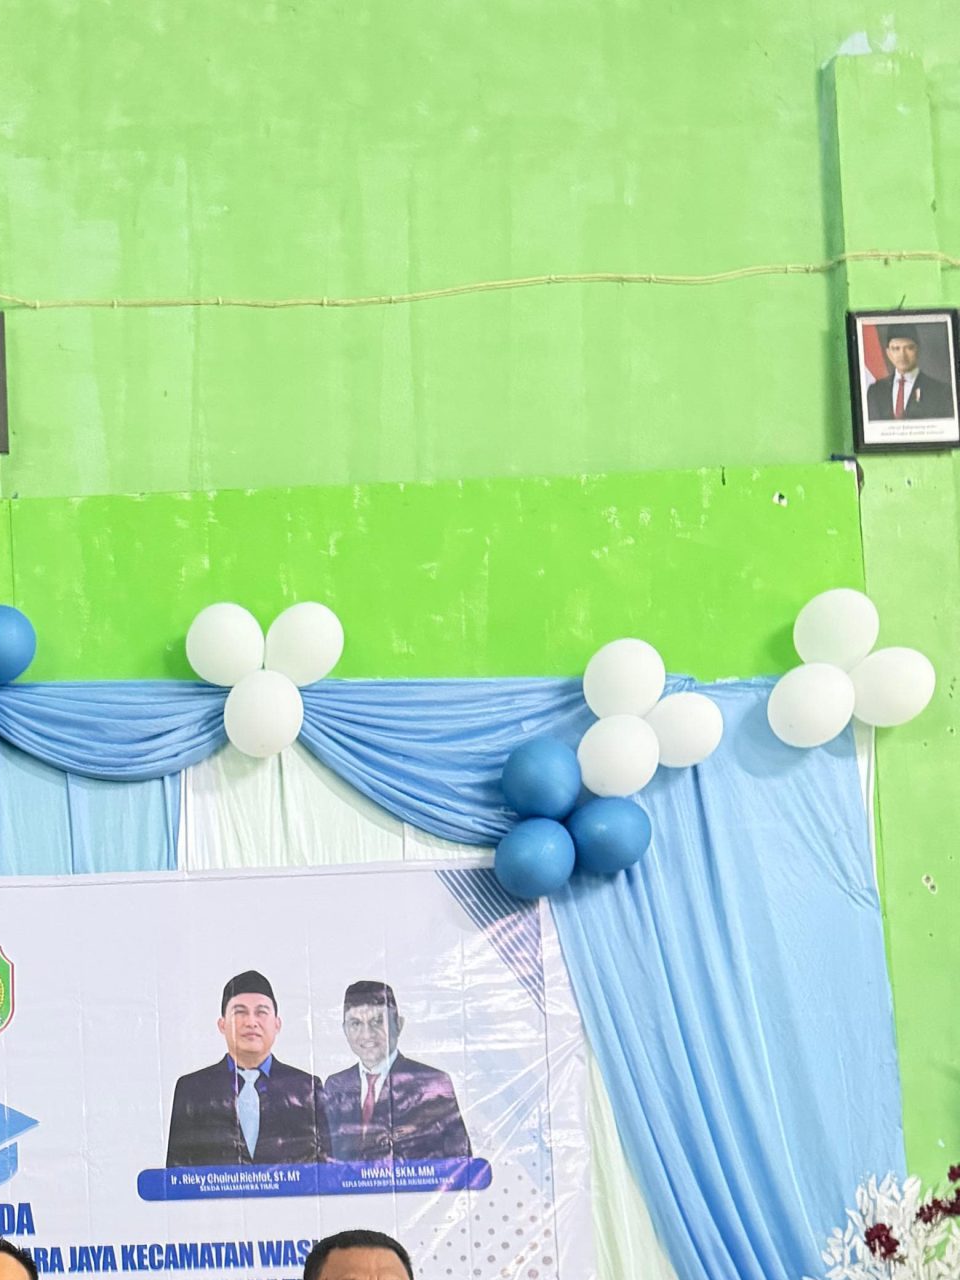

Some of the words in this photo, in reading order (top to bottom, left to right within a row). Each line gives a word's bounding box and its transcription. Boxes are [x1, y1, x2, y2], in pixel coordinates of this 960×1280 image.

[68, 1245, 118, 1272] JAYA
[121, 1241, 254, 1271] KECAMATAN
[258, 1239, 311, 1267] WAS
